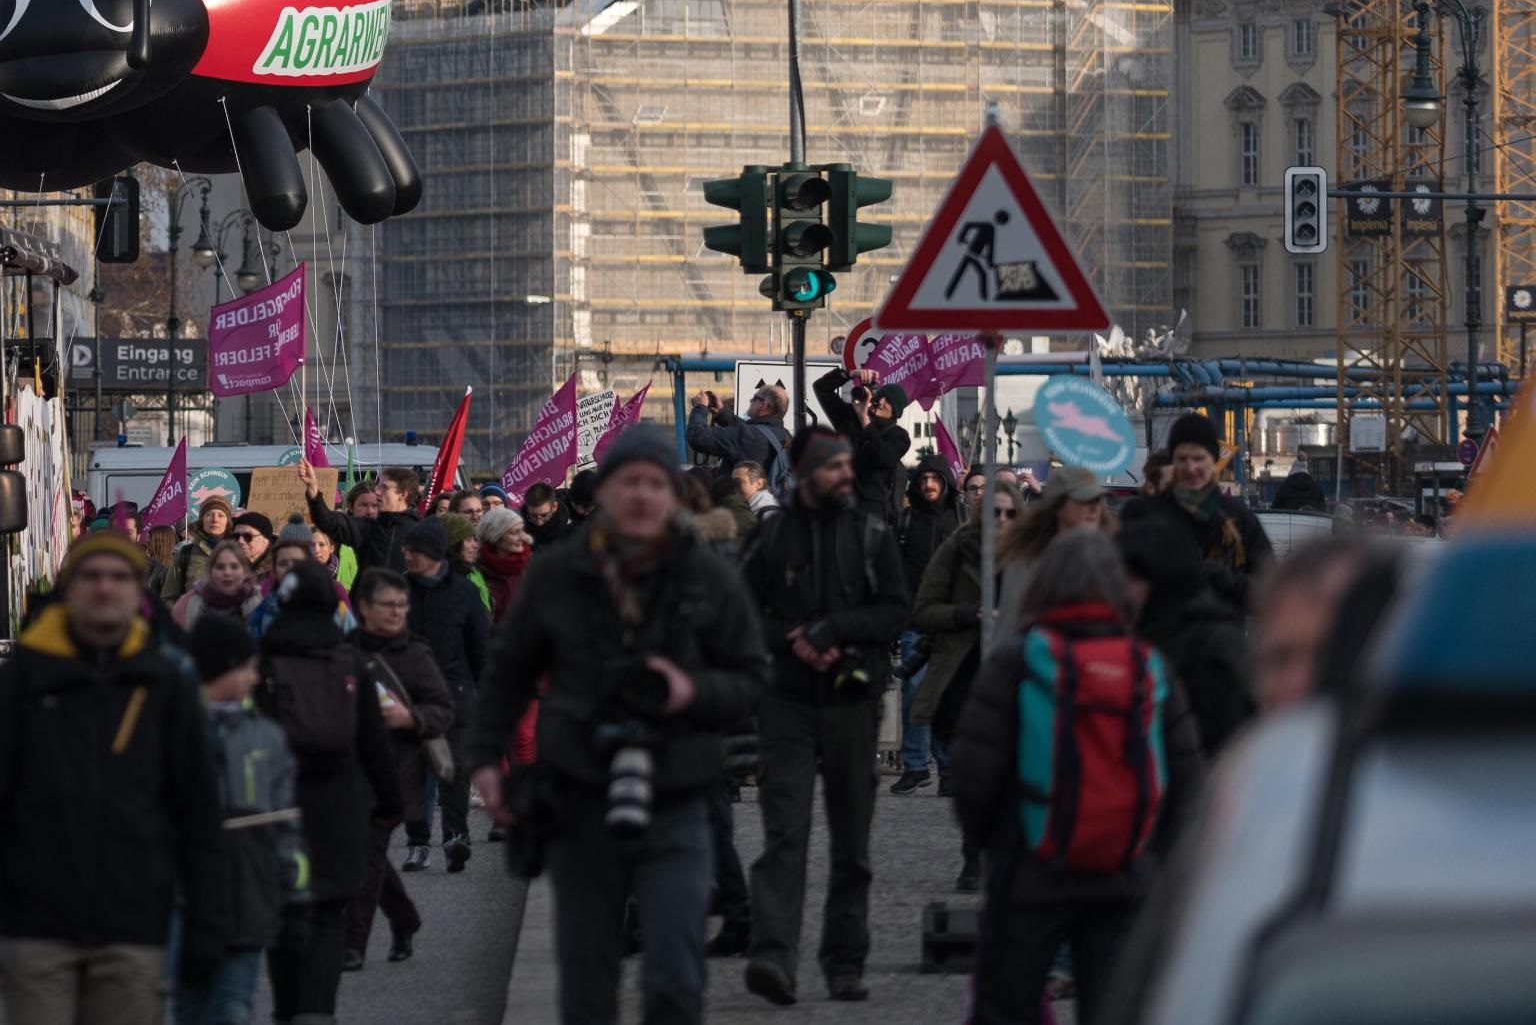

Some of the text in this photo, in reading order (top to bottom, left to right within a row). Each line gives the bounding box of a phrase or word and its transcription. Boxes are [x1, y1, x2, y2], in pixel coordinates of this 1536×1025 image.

[117, 345, 193, 363] Eingang
[579, 409, 591, 418] UNS
[592, 404, 603, 413] ALLE
[199, 470, 229, 480] SCHWEIN
